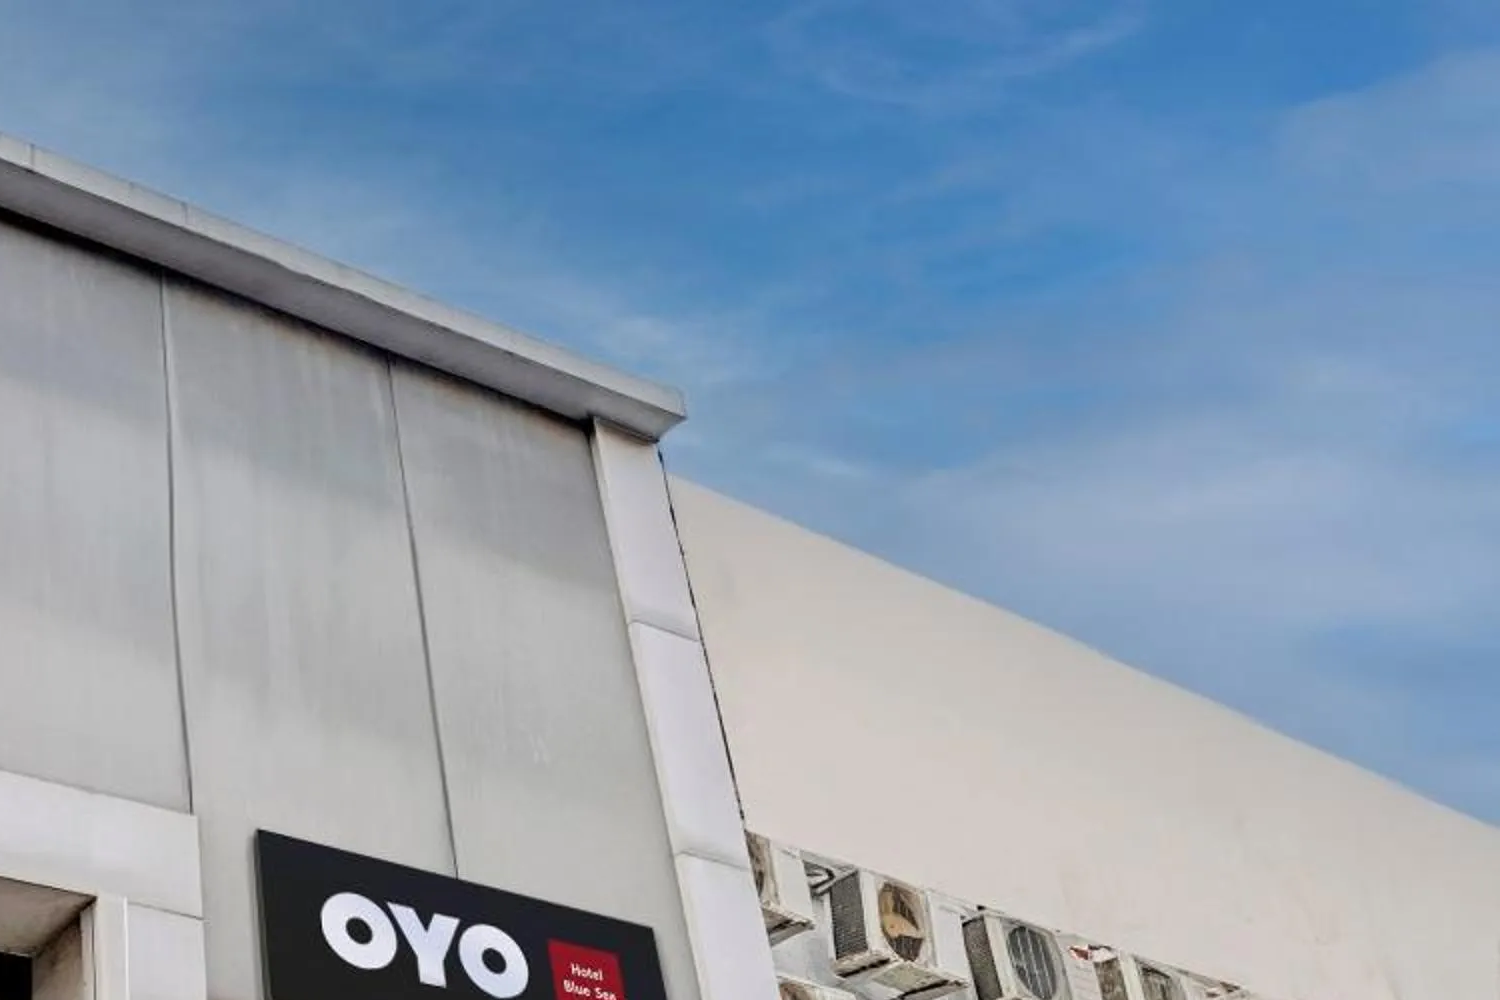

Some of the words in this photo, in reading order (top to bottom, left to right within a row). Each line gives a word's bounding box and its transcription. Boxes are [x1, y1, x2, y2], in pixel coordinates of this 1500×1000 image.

[321, 892, 529, 999] OYO
[571, 962, 603, 981] Hotel
[563, 979, 591, 997] Blue
